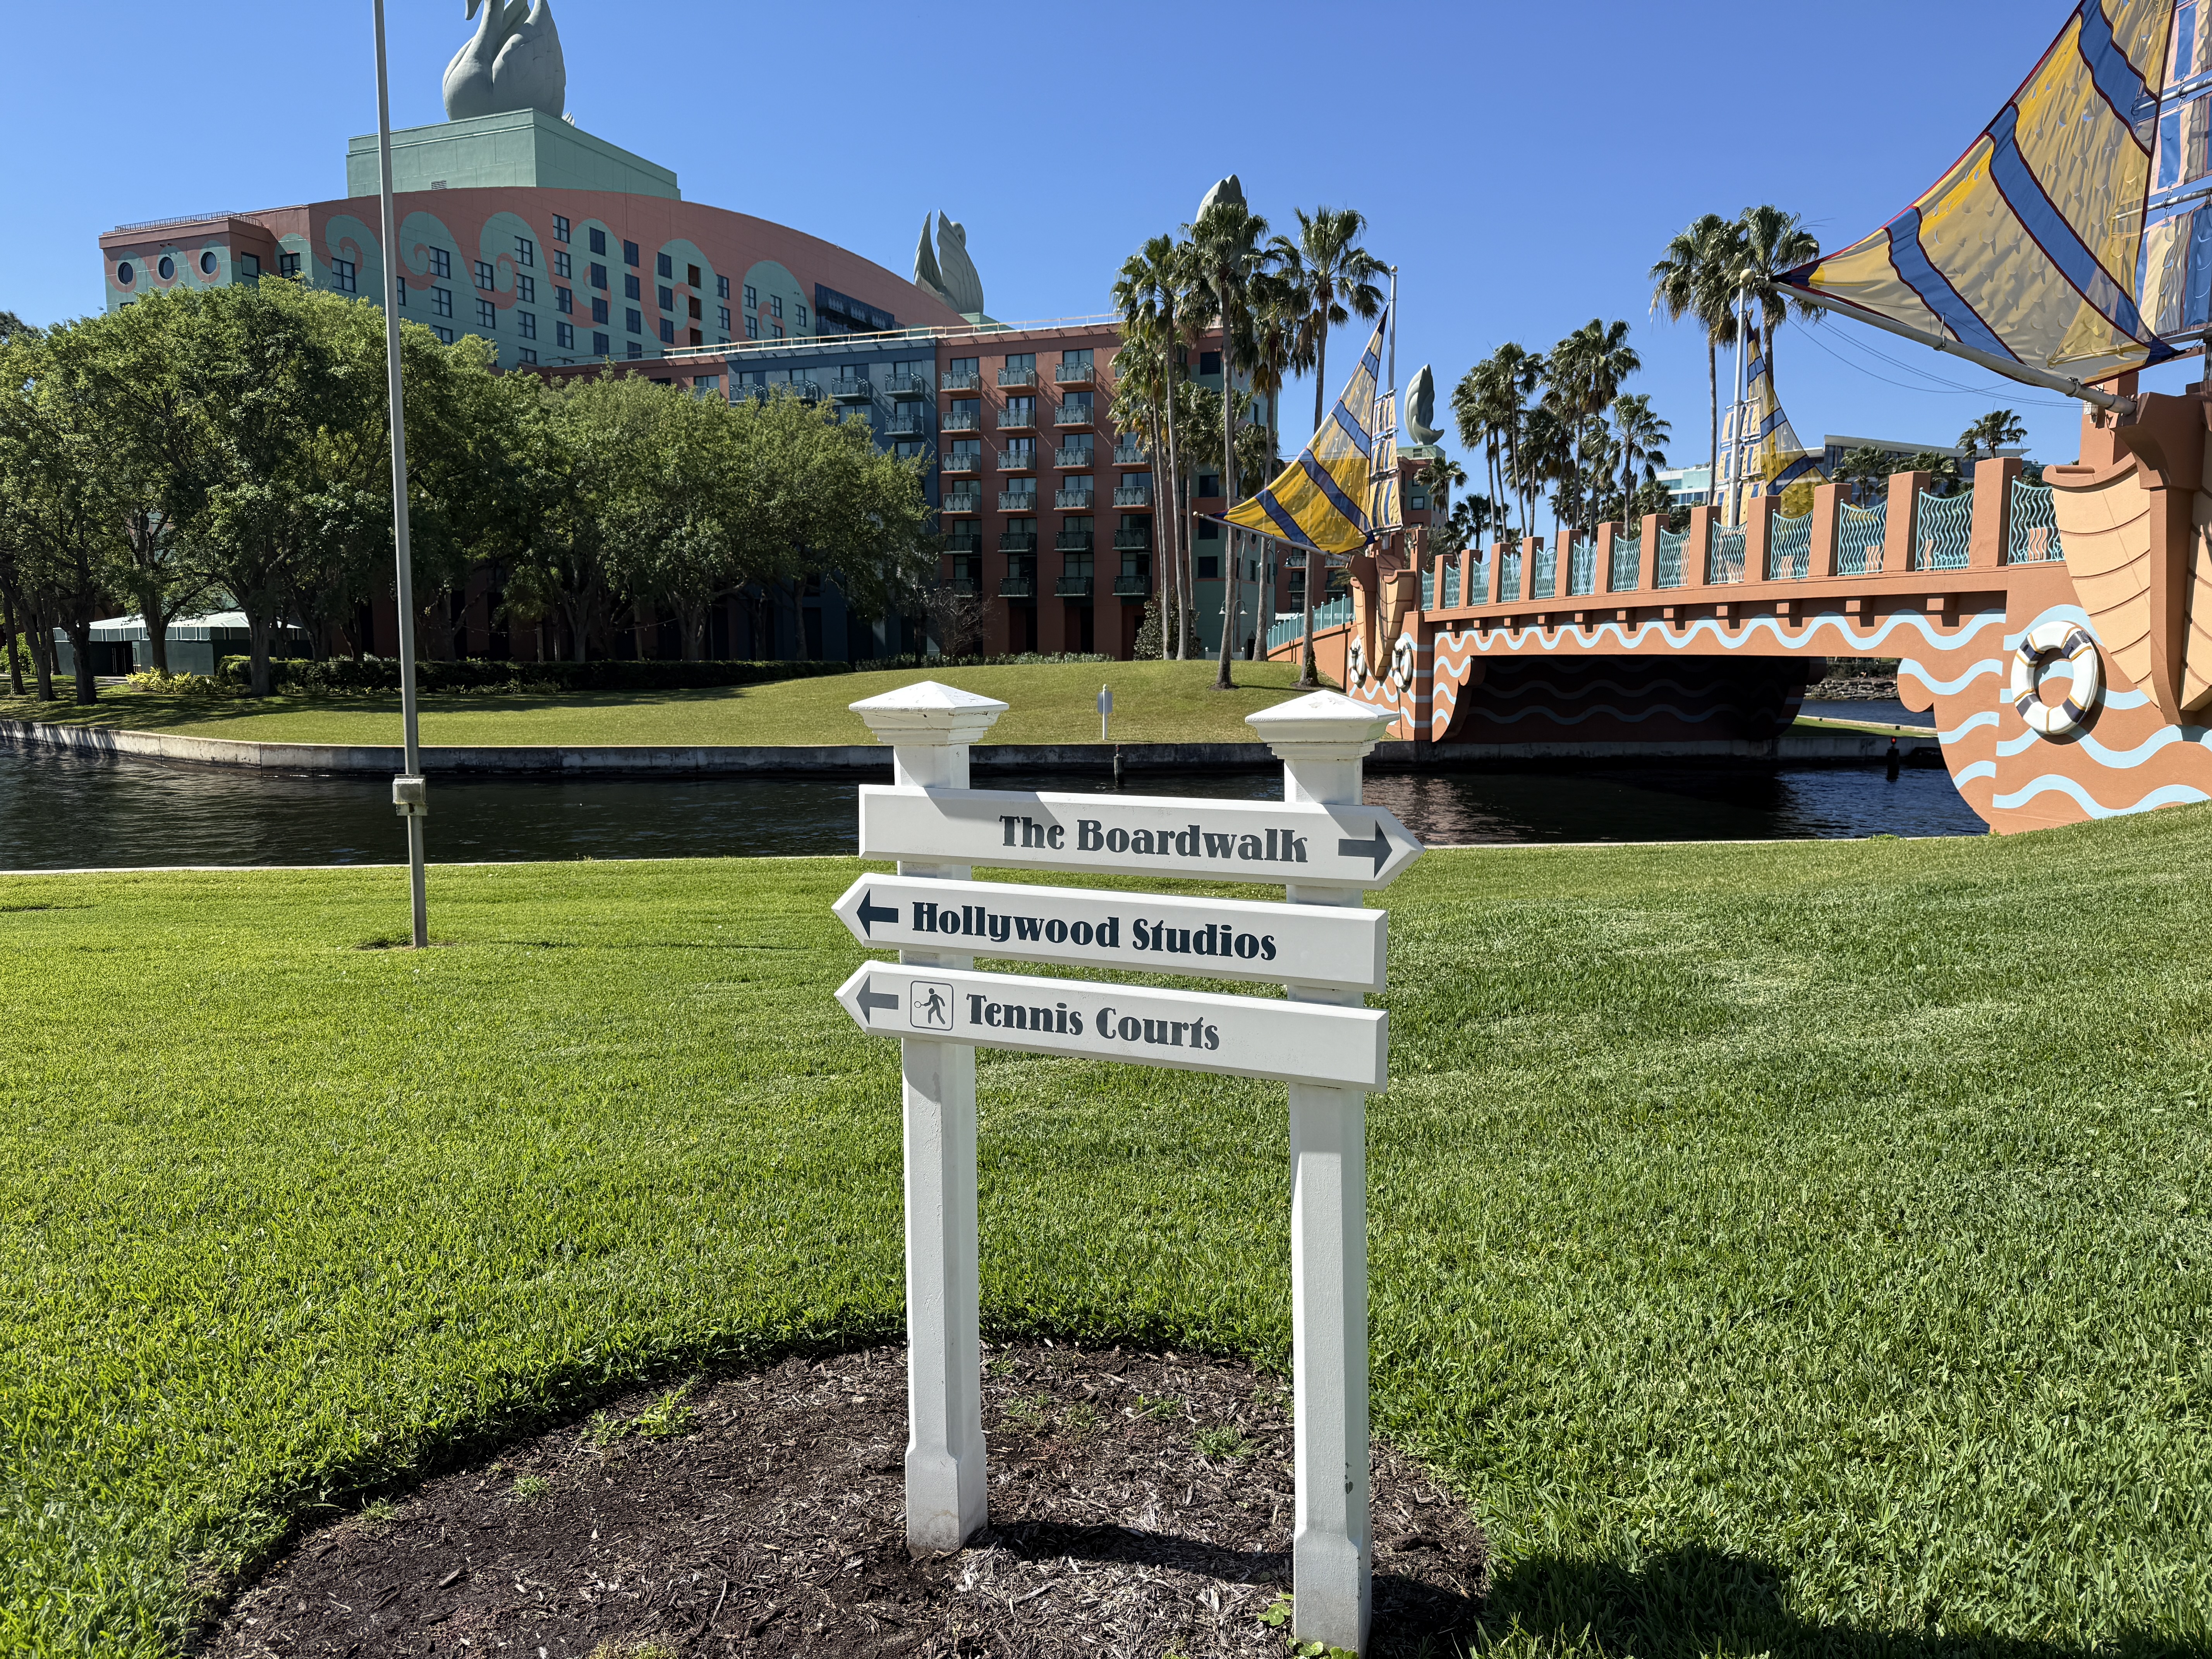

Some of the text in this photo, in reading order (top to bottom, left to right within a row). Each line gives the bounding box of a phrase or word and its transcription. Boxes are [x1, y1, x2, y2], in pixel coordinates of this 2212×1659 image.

[999, 815, 1308, 862] The Boardwalk
[912, 902, 1276, 960] Hollywood Studios
[966, 994, 1219, 1050] Tennis Courts
